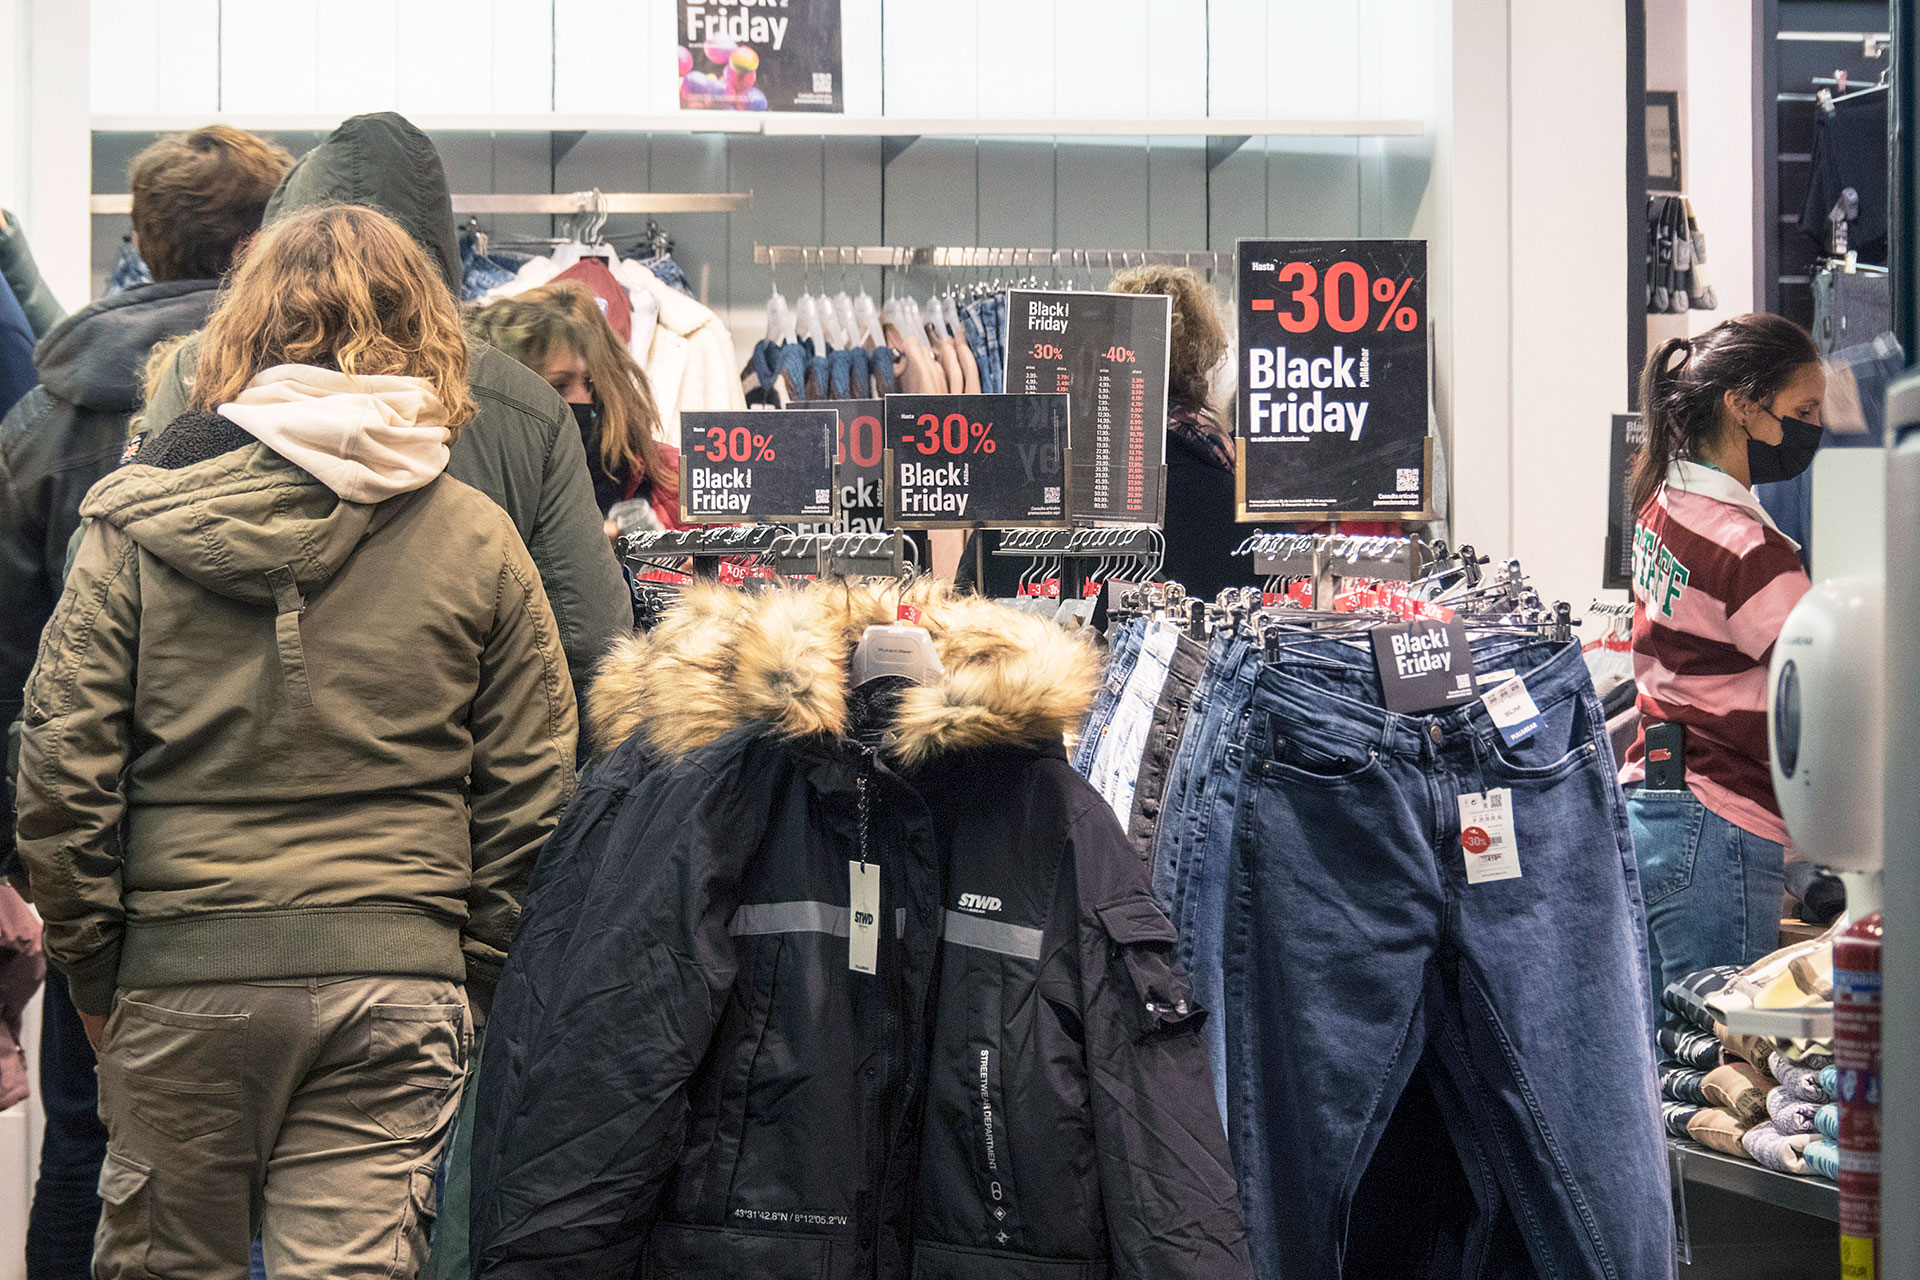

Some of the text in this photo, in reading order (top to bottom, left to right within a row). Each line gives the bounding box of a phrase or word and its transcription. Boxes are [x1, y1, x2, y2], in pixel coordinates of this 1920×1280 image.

[687, 7, 789, 50] Friday
[1251, 262, 1275, 271] Hasta
[1029, 301, 1064, 317] Black
[1251, 261, 1418, 333] -30%
[1028, 316, 1069, 335] Friday
[1028, 343, 1136, 363] -30% -40%
[1249, 346, 1356, 389] Black
[1250, 391, 1369, 441] Friday
[694, 427, 775, 462] -30%
[902, 414, 996, 455] -30%
[692, 467, 745, 489] Black
[901, 462, 961, 486] Black
[692, 489, 751, 514] Friday
[901, 487, 969, 516] Friday
[1391, 629, 1443, 655] Black
[1396, 650, 1451, 675] Friday
[854, 911, 874, 926] STWD
[980, 1049, 997, 1170] STREETWEAR DEPARTMENT
